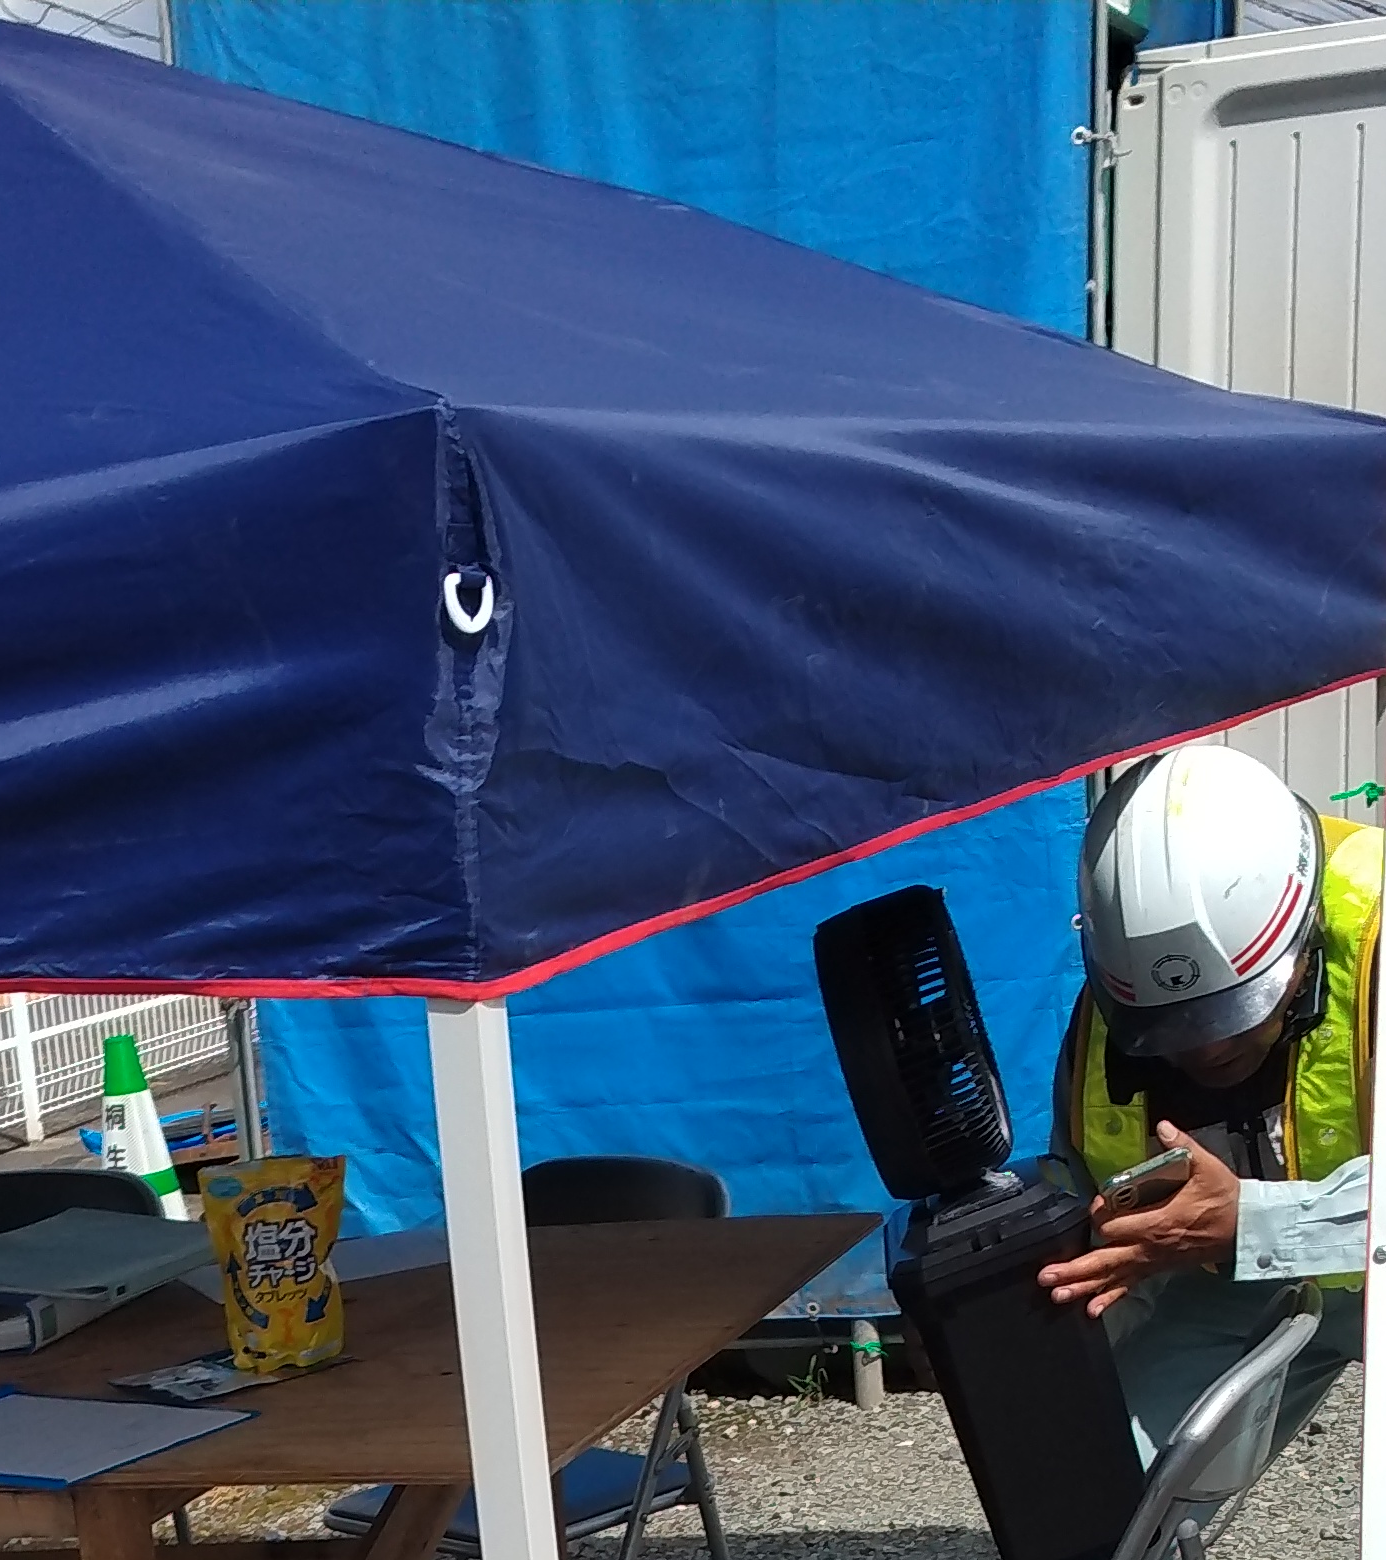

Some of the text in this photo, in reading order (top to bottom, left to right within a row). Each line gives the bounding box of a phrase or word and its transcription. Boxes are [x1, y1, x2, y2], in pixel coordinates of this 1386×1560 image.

[245, 1218, 318, 1262] 塩分
[248, 1258, 317, 1288] チャージ
